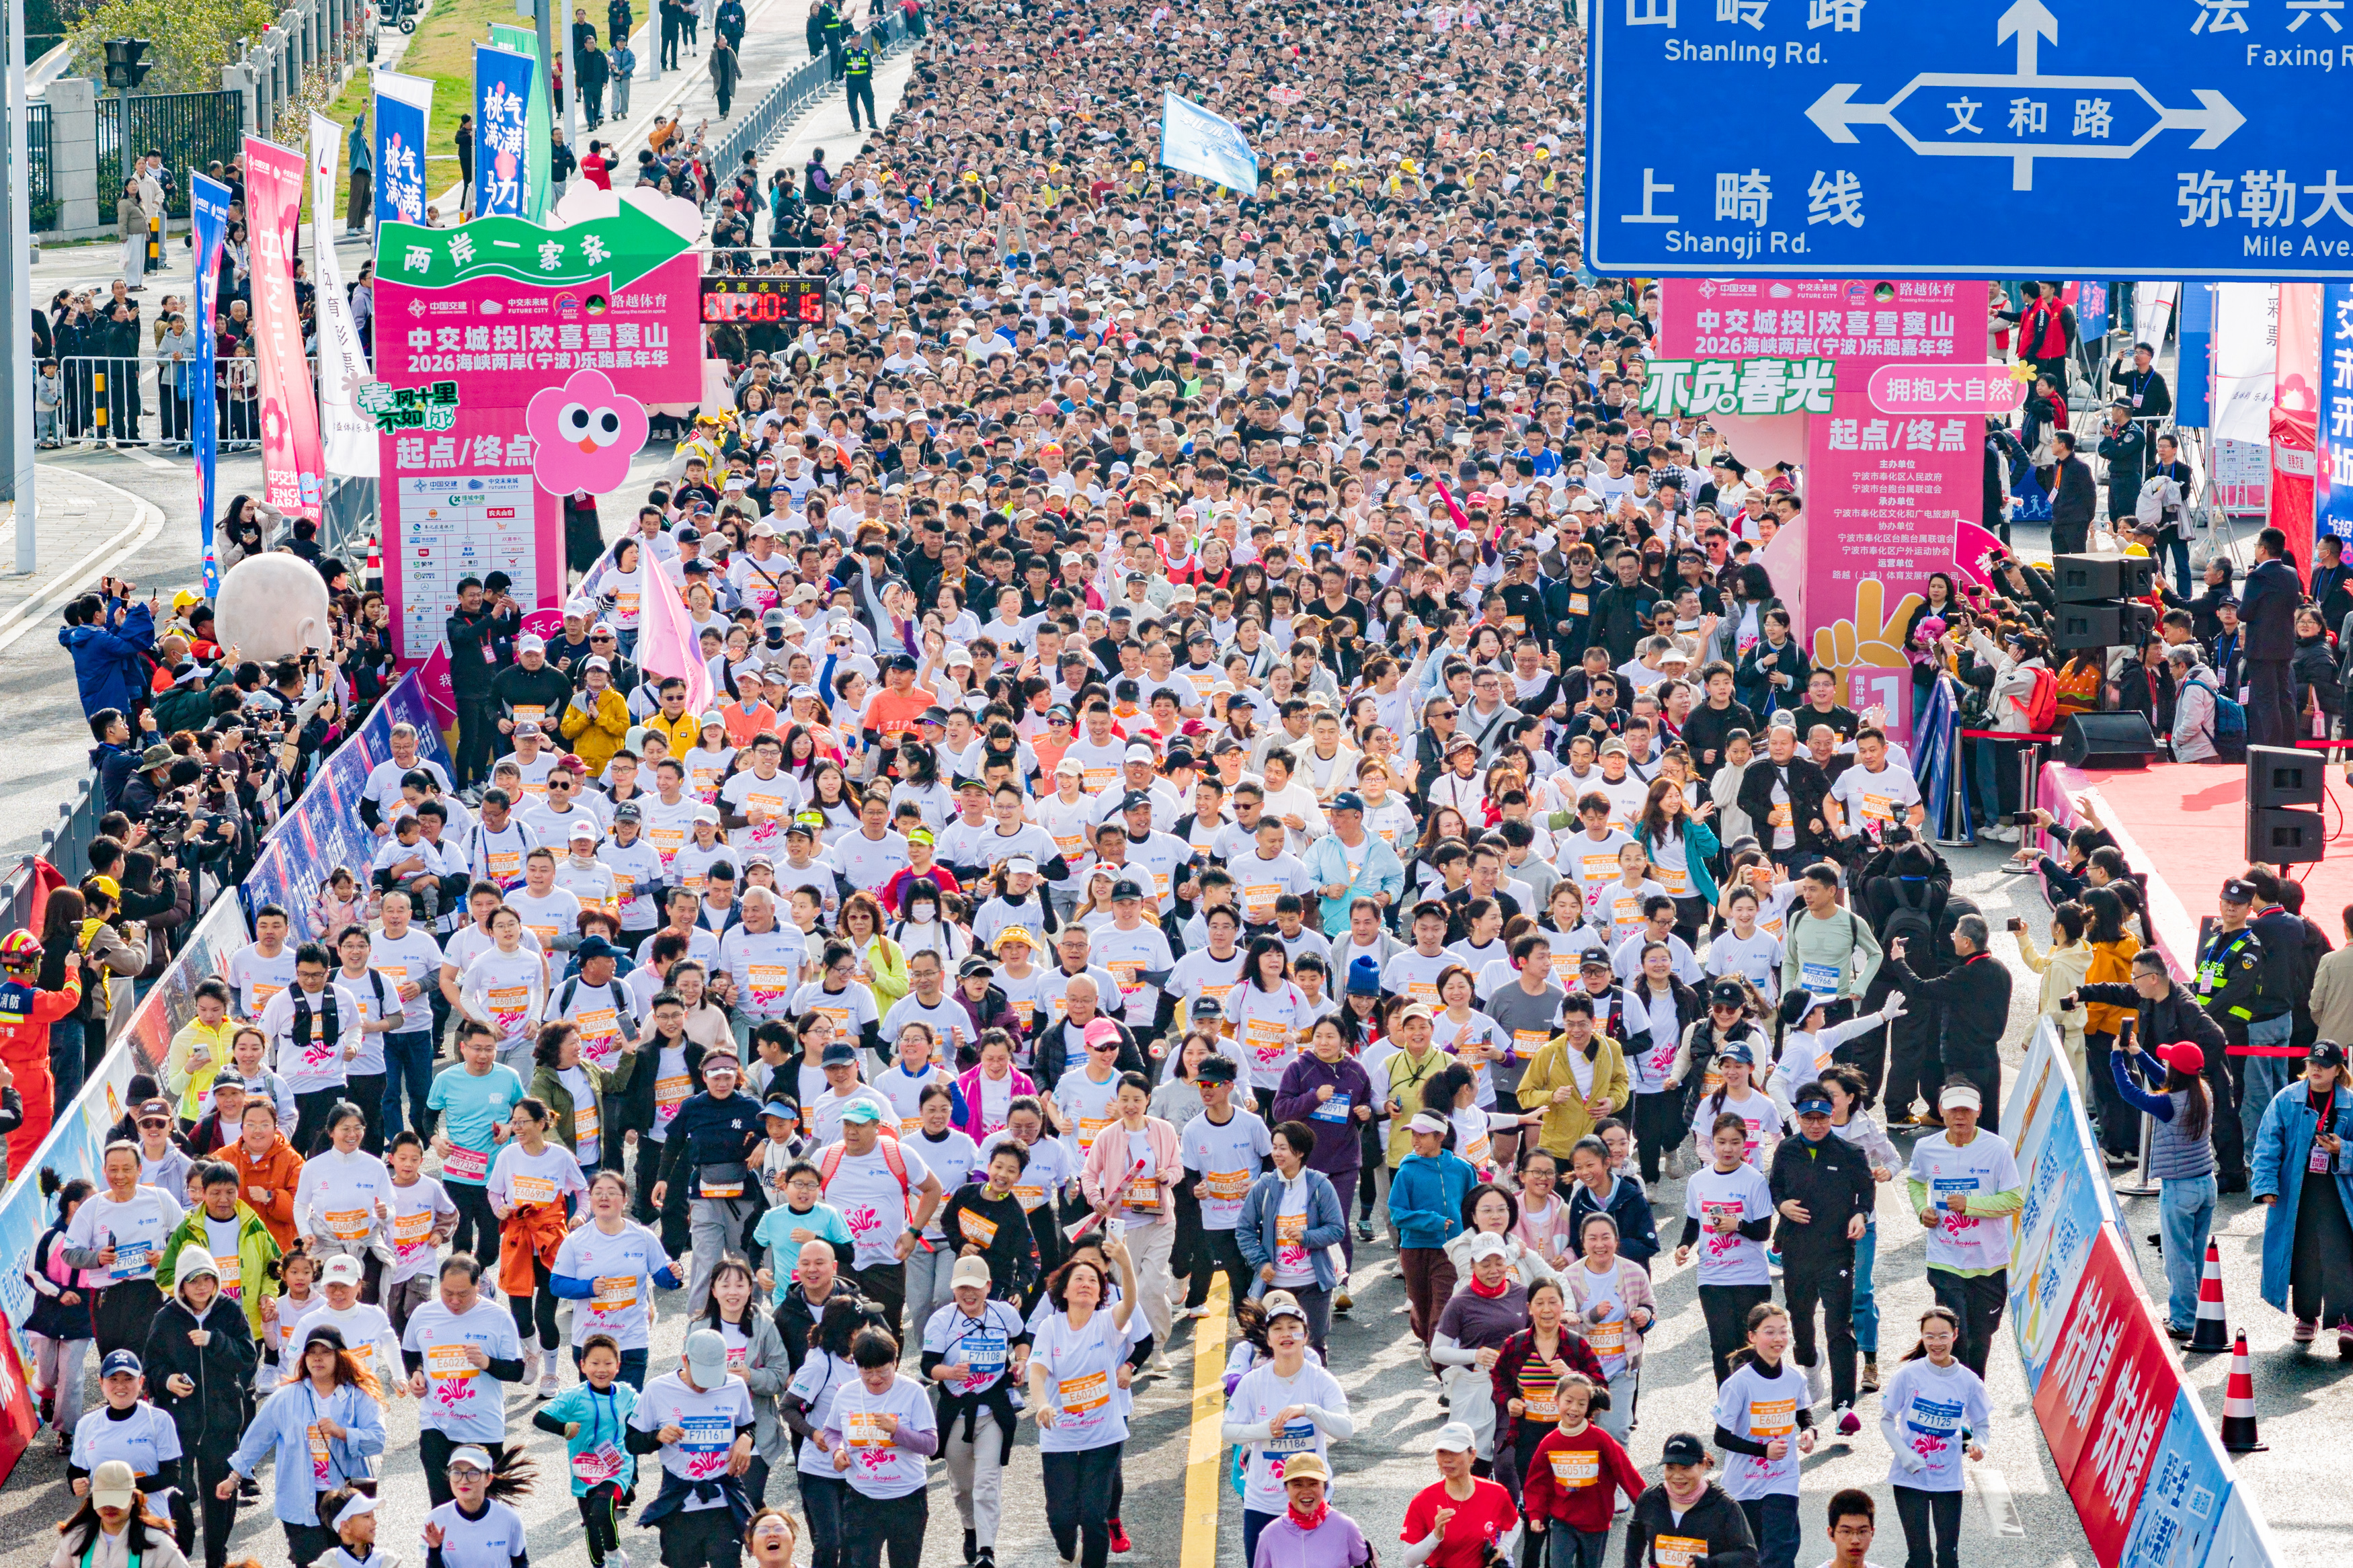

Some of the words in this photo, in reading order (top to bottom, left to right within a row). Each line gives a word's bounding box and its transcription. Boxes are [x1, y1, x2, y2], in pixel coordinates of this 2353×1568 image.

[1786, 42, 1828, 64] Rd.
[2247, 44, 2334, 73] Faxing
[483, 86, 523, 126] 桃气
[1946, 96, 2114, 138] 文和路
[484, 122, 522, 159] 满满
[385, 138, 422, 183] 桃气
[485, 170, 518, 208] 马力
[386, 176, 422, 220] 满满
[1621, 168, 1866, 228] 上畸线
[2177, 169, 2353, 228] 弥勒大
[1665, 230, 1761, 259] Shangji
[1770, 231, 1811, 253] Rd.
[2243, 235, 2292, 257] Mile
[2301, 235, 2353, 257] Ave.
[403, 231, 612, 274] 两岸一家亲
[737, 282, 811, 292] 赛虎计时
[1720, 284, 1757, 293] 中国交建
[1797, 283, 1837, 292] 中交未来城
[1900, 282, 1955, 296] 路越体育
[430, 302, 467, 311] 中国交建
[508, 298, 548, 306] 中交未来城
[611, 294, 667, 308] 路越体育
[703, 292, 824, 321] 00:00:16
[1695, 336, 1954, 356] 2026海峡两岸(宁波)乐跑嘉年华
[408, 350, 669, 372] 2026海峡两岸(宁波)乐跑嘉年华
[1645, 359, 1835, 415] 不负春光
[1886, 378, 2013, 403] 拥抱大自然
[358, 382, 457, 413] 春风十里
[377, 405, 453, 431] 不如你
[1828, 418, 1966, 452] 起点/终点
[396, 434, 534, 470] 起点/终点
[1879, 460, 1915, 469] 主办单位
[1852, 472, 1942, 482] 宁波市奉化区人民政府
[1852, 485, 1942, 494] 宁波市台胞台属联谊会
[1878, 497, 1915, 506] 承办单位
[488, 509, 514, 517] 农夫山泉
[1834, 509, 1960, 520] 宁波市奉化区文化和广电旅游局
[1878, 522, 1914, 530] 协办单位
[1837, 533, 1954, 543] 宁波市奉化区台胞台属联谊会
[1842, 546, 1950, 556] 宁波市奉化区户外运动协会
[1878, 559, 1913, 567] 运营单位
[439, 673, 452, 687] 我
[1855, 675, 1866, 705] 倒计时
[1871, 675, 1899, 727] 1
[654, 838, 678, 846] E60265
[1589, 864, 1615, 872] E60333
[1251, 893, 1276, 903] E60695
[754, 975, 781, 983] E60293
[1806, 975, 1832, 985] F70966
[495, 996, 522, 1005] E60130
[585, 1019, 612, 1031] E60290
[1252, 1028, 1280, 1039] E60016
[657, 1087, 686, 1099] E60686
[450, 1159, 480, 1171] H87329
[516, 1188, 546, 1200] E60693
[333, 1220, 362, 1231] E60098
[401, 1224, 428, 1236] E60026
[1589, 1335, 1620, 1345] E60219
[969, 1351, 1000, 1362] F71108
[2052, 1275, 2118, 1432] 农夫山泉
[1070, 1387, 1103, 1402] E60211
[1060, 1419, 1076, 1428] hello
[1759, 1413, 1791, 1424] E60217
[1917, 1413, 1952, 1427] F71125
[689, 1430, 724, 1440] F71161
[2090, 1356, 2156, 1525] 农夫山泉
[1271, 1439, 1306, 1449] F71186
[1556, 1465, 1591, 1475] E60512
